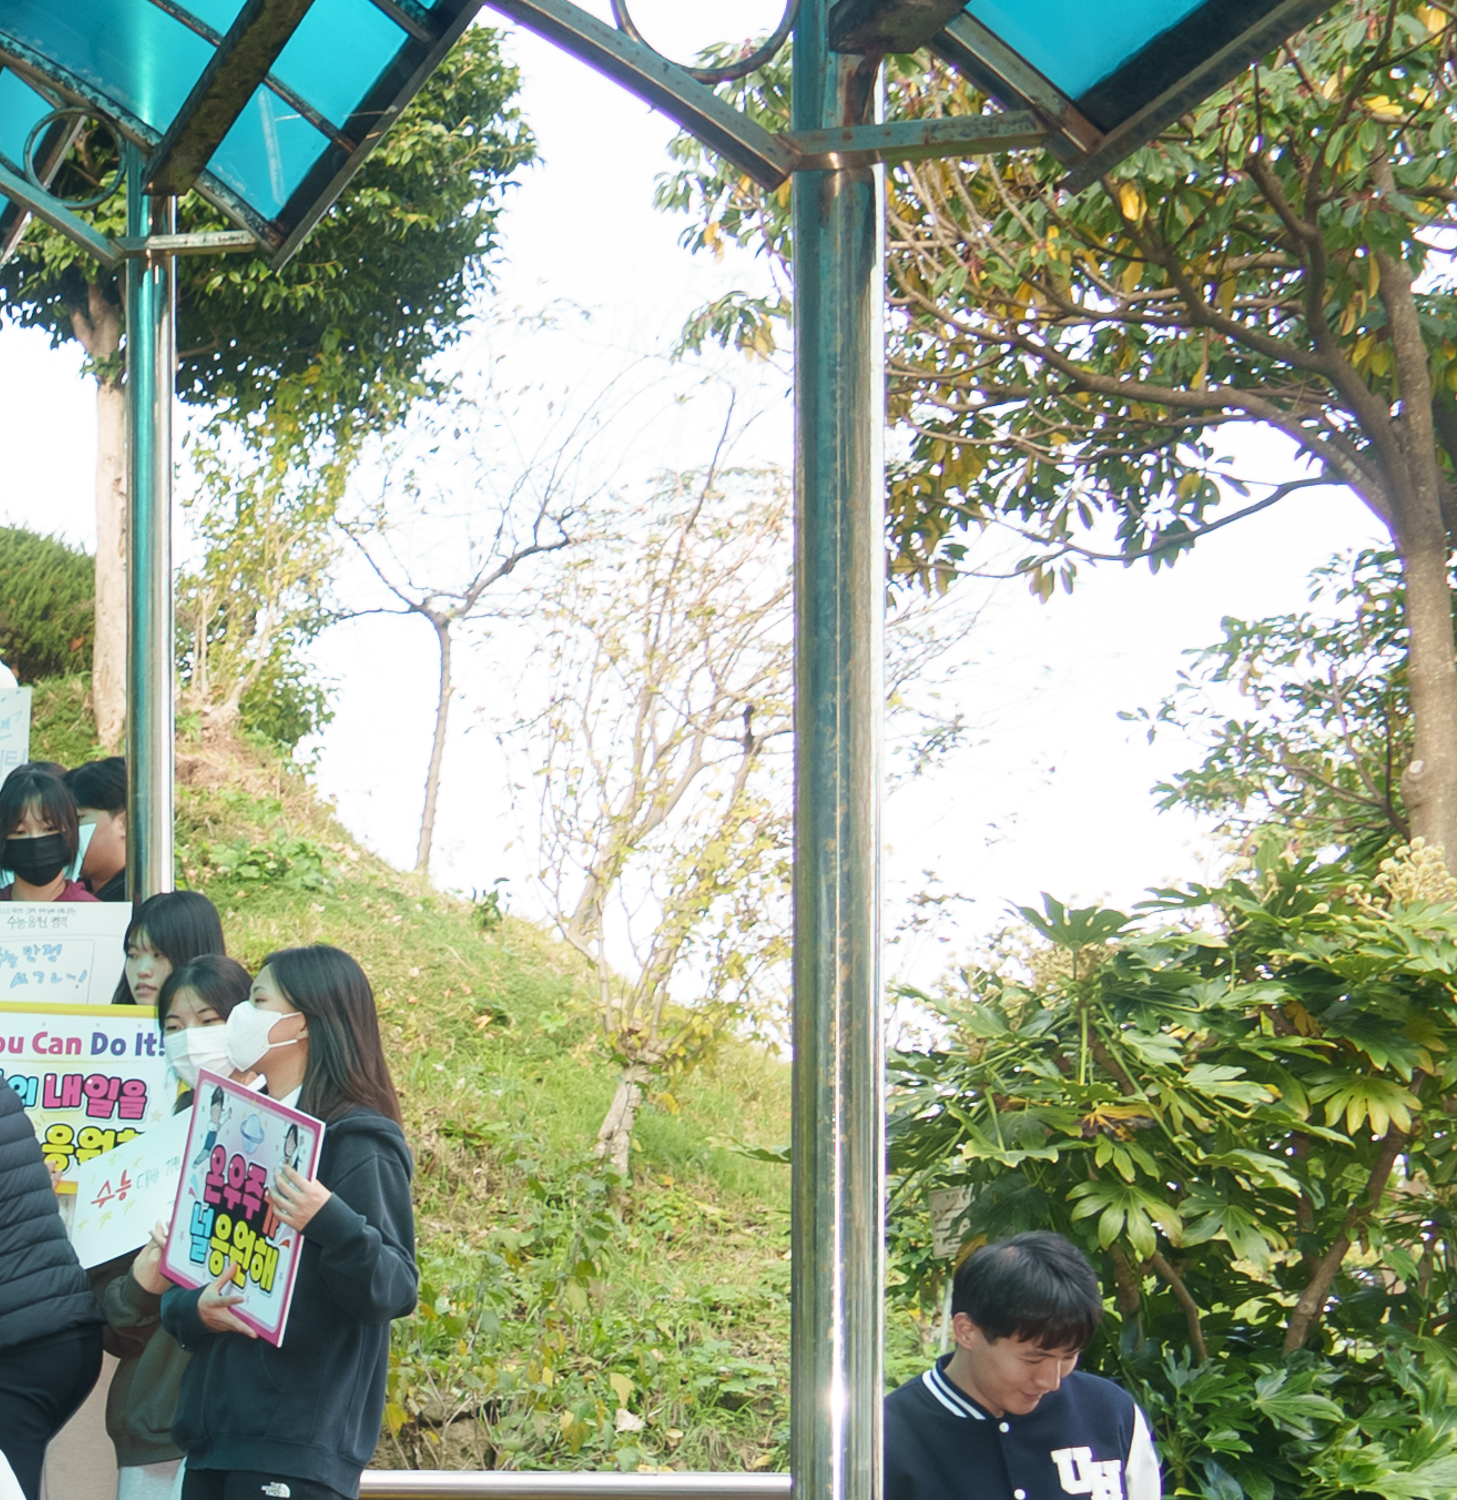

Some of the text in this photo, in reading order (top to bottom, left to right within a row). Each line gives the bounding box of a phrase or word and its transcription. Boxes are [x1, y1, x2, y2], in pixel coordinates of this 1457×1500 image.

[23, 943, 63, 964] 만점
[32, 1031, 83, 1056] Can
[90, 1032, 127, 1058] Do
[134, 1032, 166, 1057] It!
[42, 1073, 148, 1120] 내일을
[90, 1168, 134, 1209] 수능
[189, 1200, 281, 1293] 널 응원해
